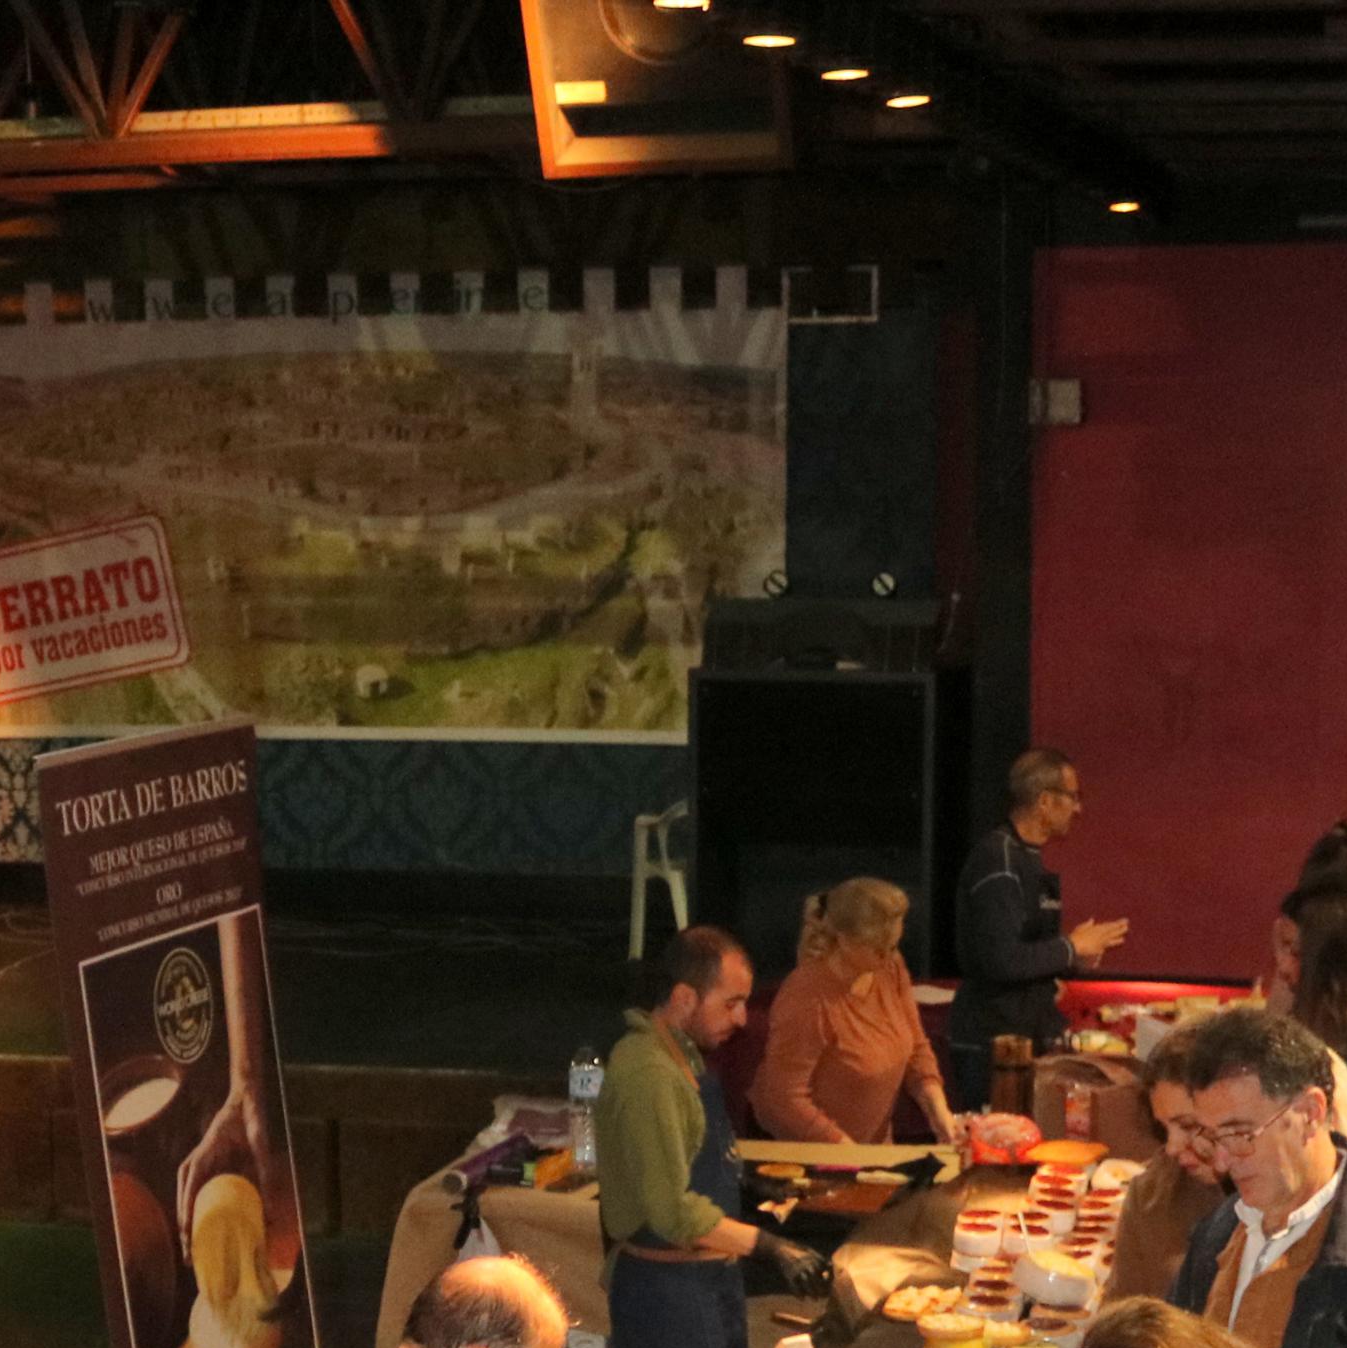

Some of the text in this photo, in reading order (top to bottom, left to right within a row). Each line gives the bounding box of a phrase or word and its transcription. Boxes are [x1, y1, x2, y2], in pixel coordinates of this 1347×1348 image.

[31, 613, 168, 665] vacaciones
[56, 759, 248, 836] TORTA DE BARROS
[88, 845, 130, 874] MEJOR
[130, 835, 172, 867] QUESO
[173, 829, 189, 850] DE
[155, 880, 183, 905] ORO
